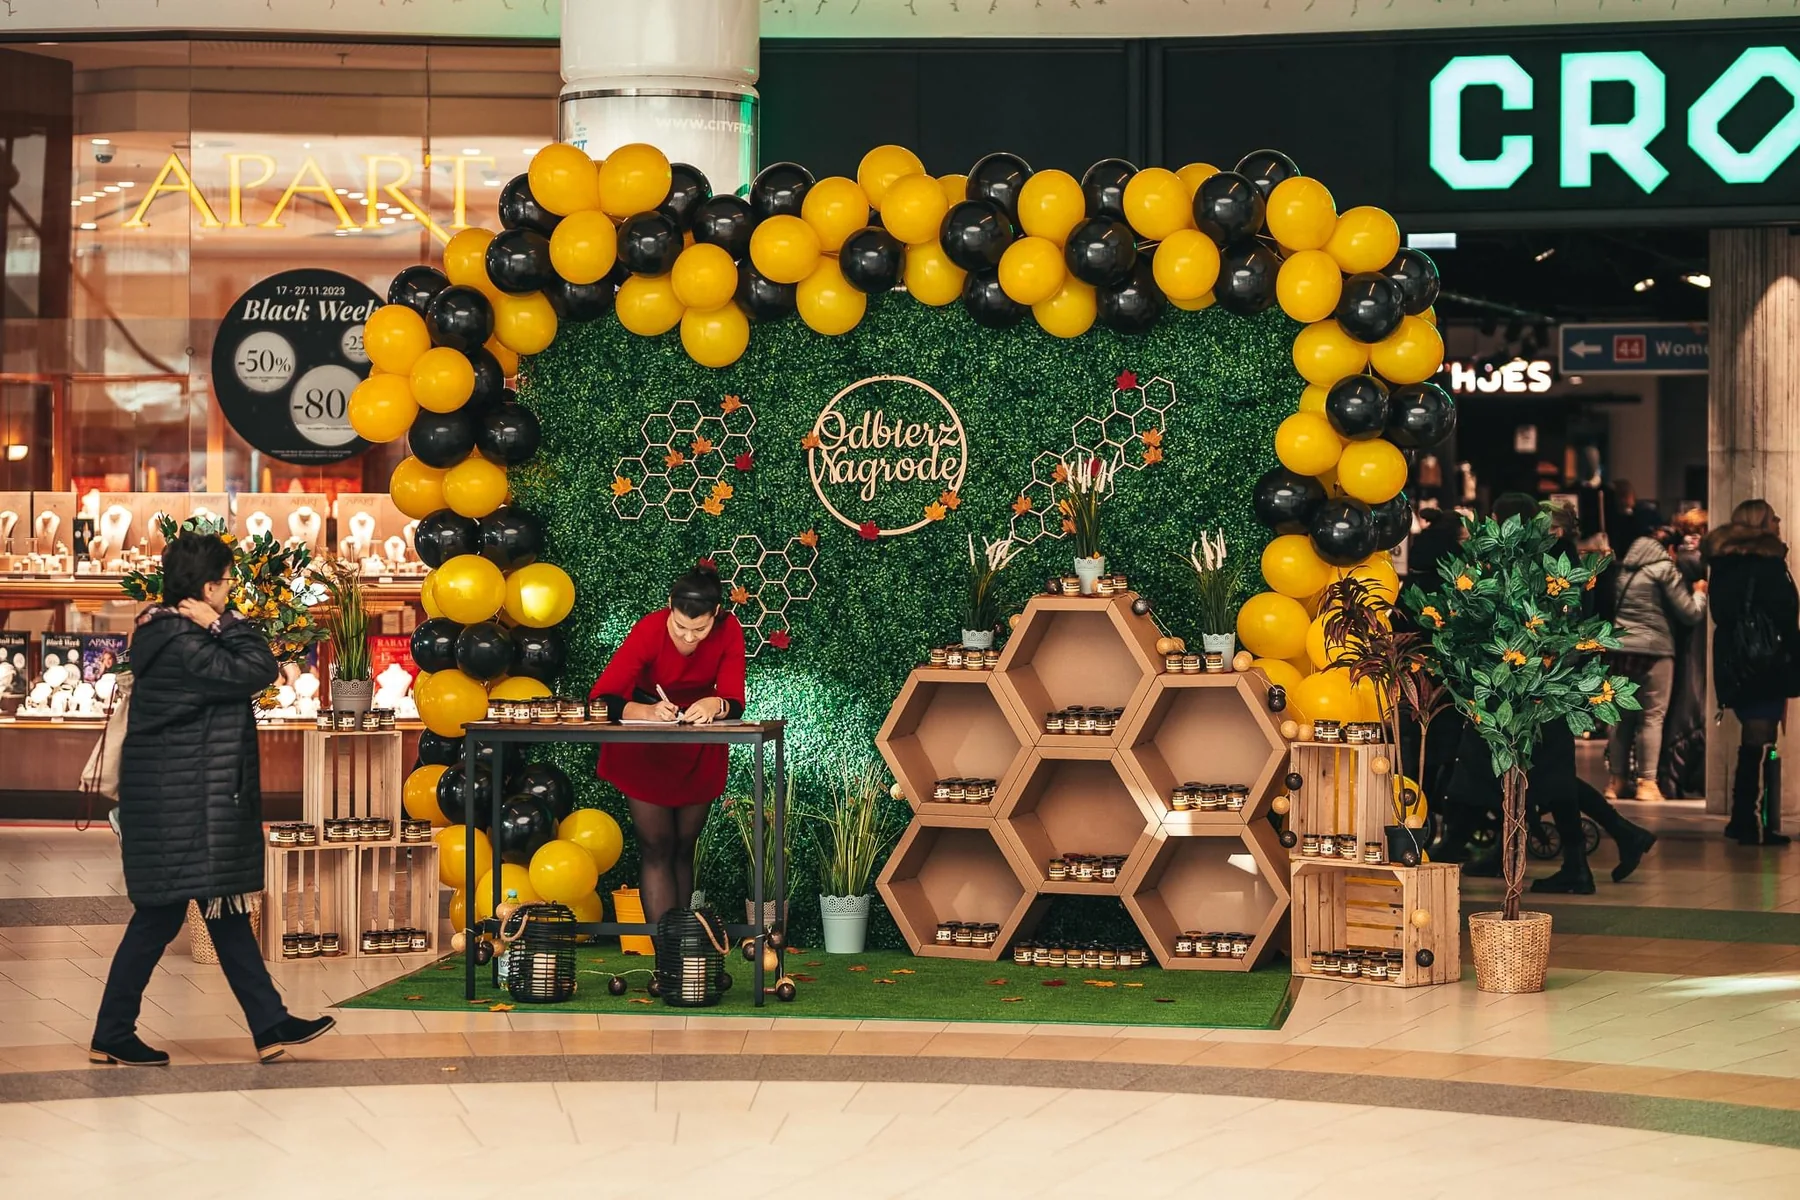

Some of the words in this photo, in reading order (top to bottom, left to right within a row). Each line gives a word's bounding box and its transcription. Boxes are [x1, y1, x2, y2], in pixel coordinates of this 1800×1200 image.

[1429, 46, 1800, 194] CRO
[121, 152, 496, 242] APART
[276, 286, 287, 295] 17
[295, 286, 346, 296] 27.11.2023
[242, 298, 310, 321] Black
[318, 299, 380, 321] Week
[238, 349, 291, 374] -50%
[1617, 340, 1641, 356] 44
[1436, 360, 1552, 393] HOES
[293, 387, 349, 420] -80
[818, 410, 962, 451] Odbierz
[818, 443, 962, 502] Nagrodę
